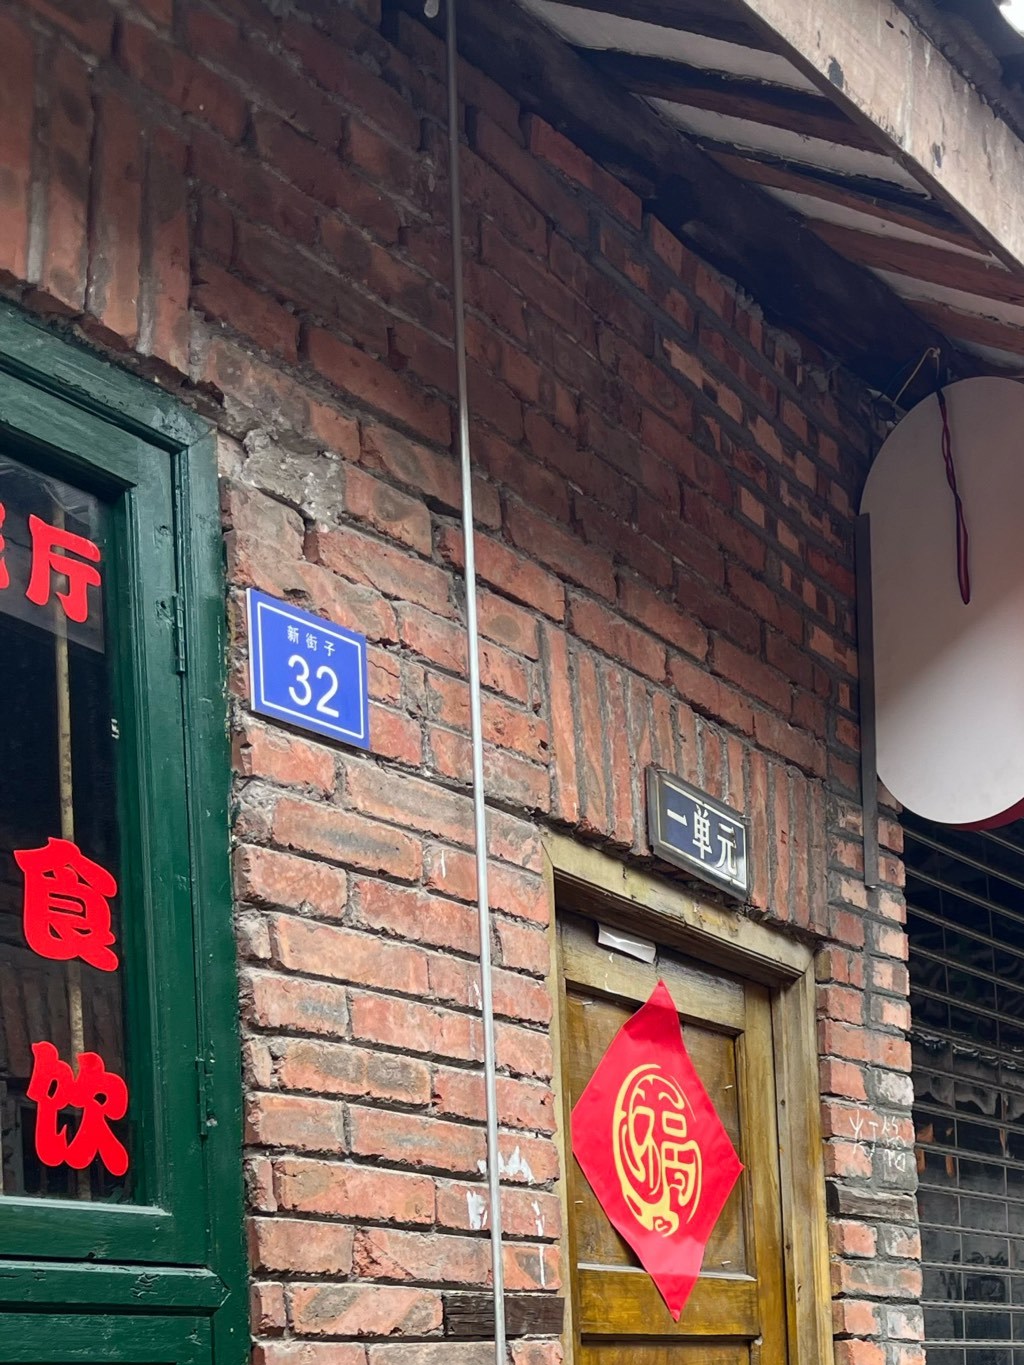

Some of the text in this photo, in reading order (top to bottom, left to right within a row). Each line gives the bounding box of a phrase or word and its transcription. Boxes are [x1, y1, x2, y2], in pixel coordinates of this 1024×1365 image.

[0, 502, 101, 623] 厅
[287, 625, 335, 657] 新街子
[288, 654, 339, 718] 32
[667, 804, 737, 875] 一单元
